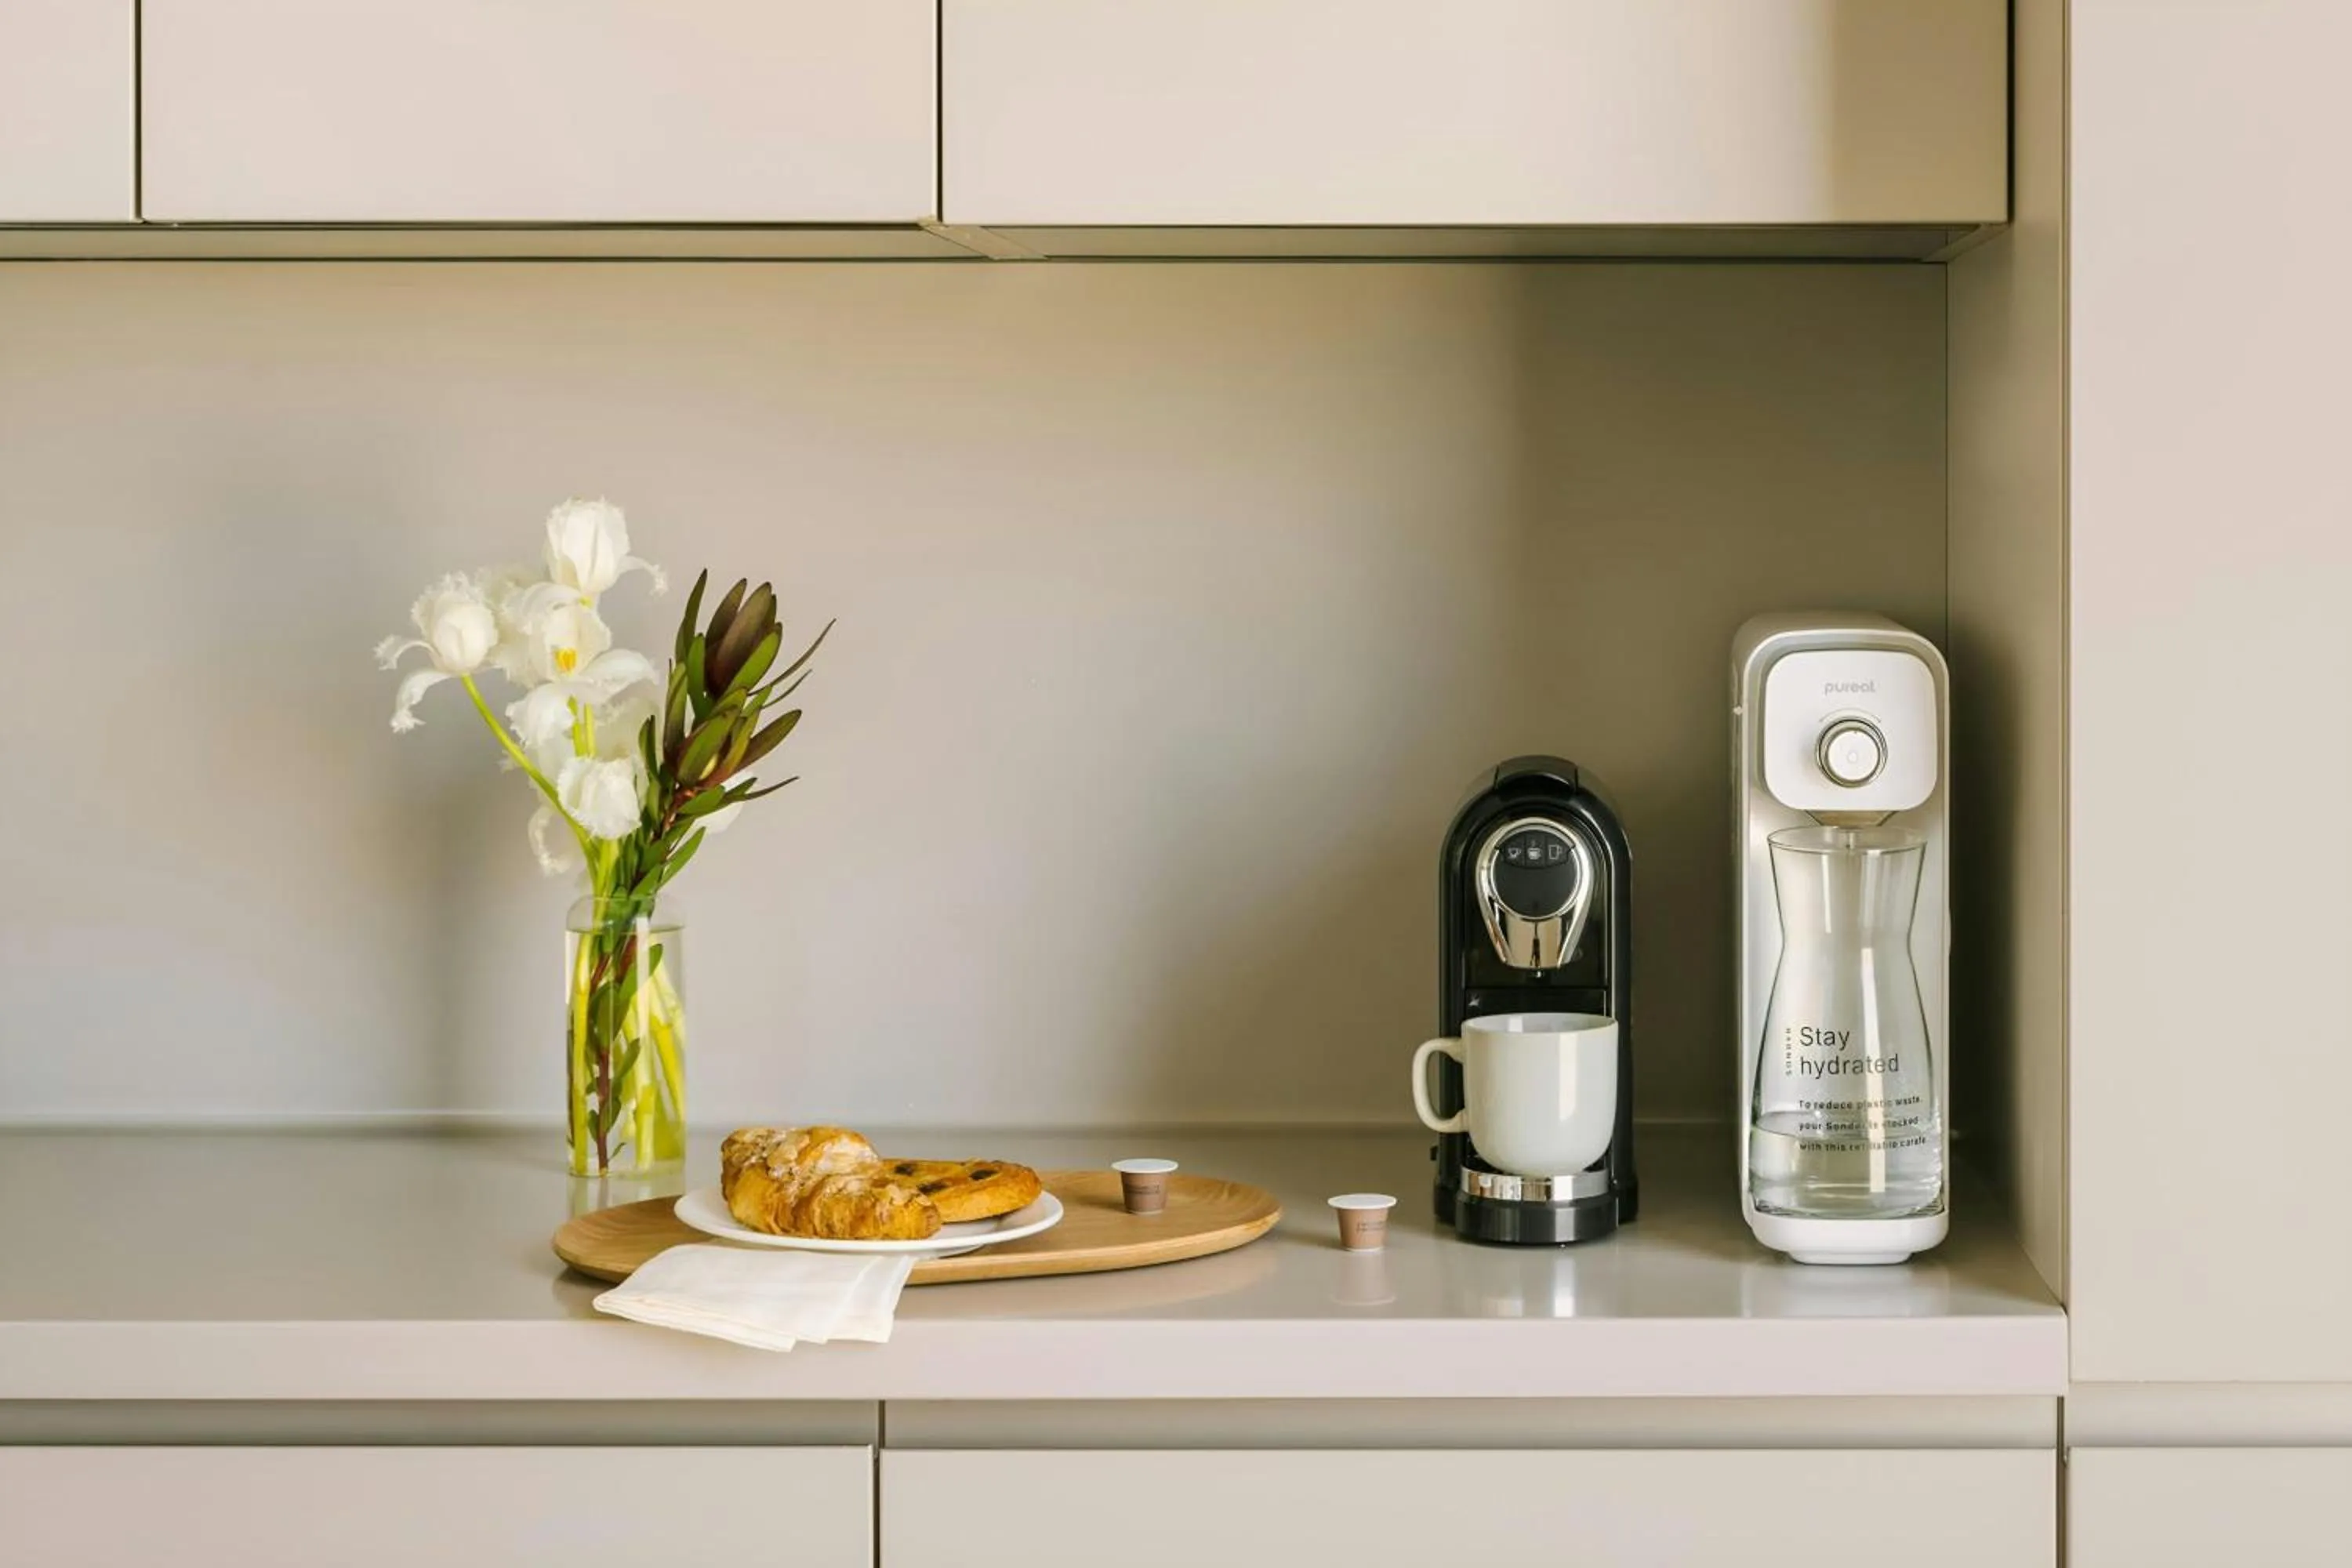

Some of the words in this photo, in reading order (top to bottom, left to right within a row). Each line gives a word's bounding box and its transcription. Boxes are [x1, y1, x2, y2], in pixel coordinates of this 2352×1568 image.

[1800, 1026, 1849, 1051] Stay
[1800, 1054, 1899, 1080] hydrated
[1799, 1100, 1811, 1109] To
[1813, 1100, 1853, 1109] reduce
[1799, 1123, 1822, 1131] your
[1799, 1142, 1822, 1151] with
[1825, 1142, 1846, 1152] this
